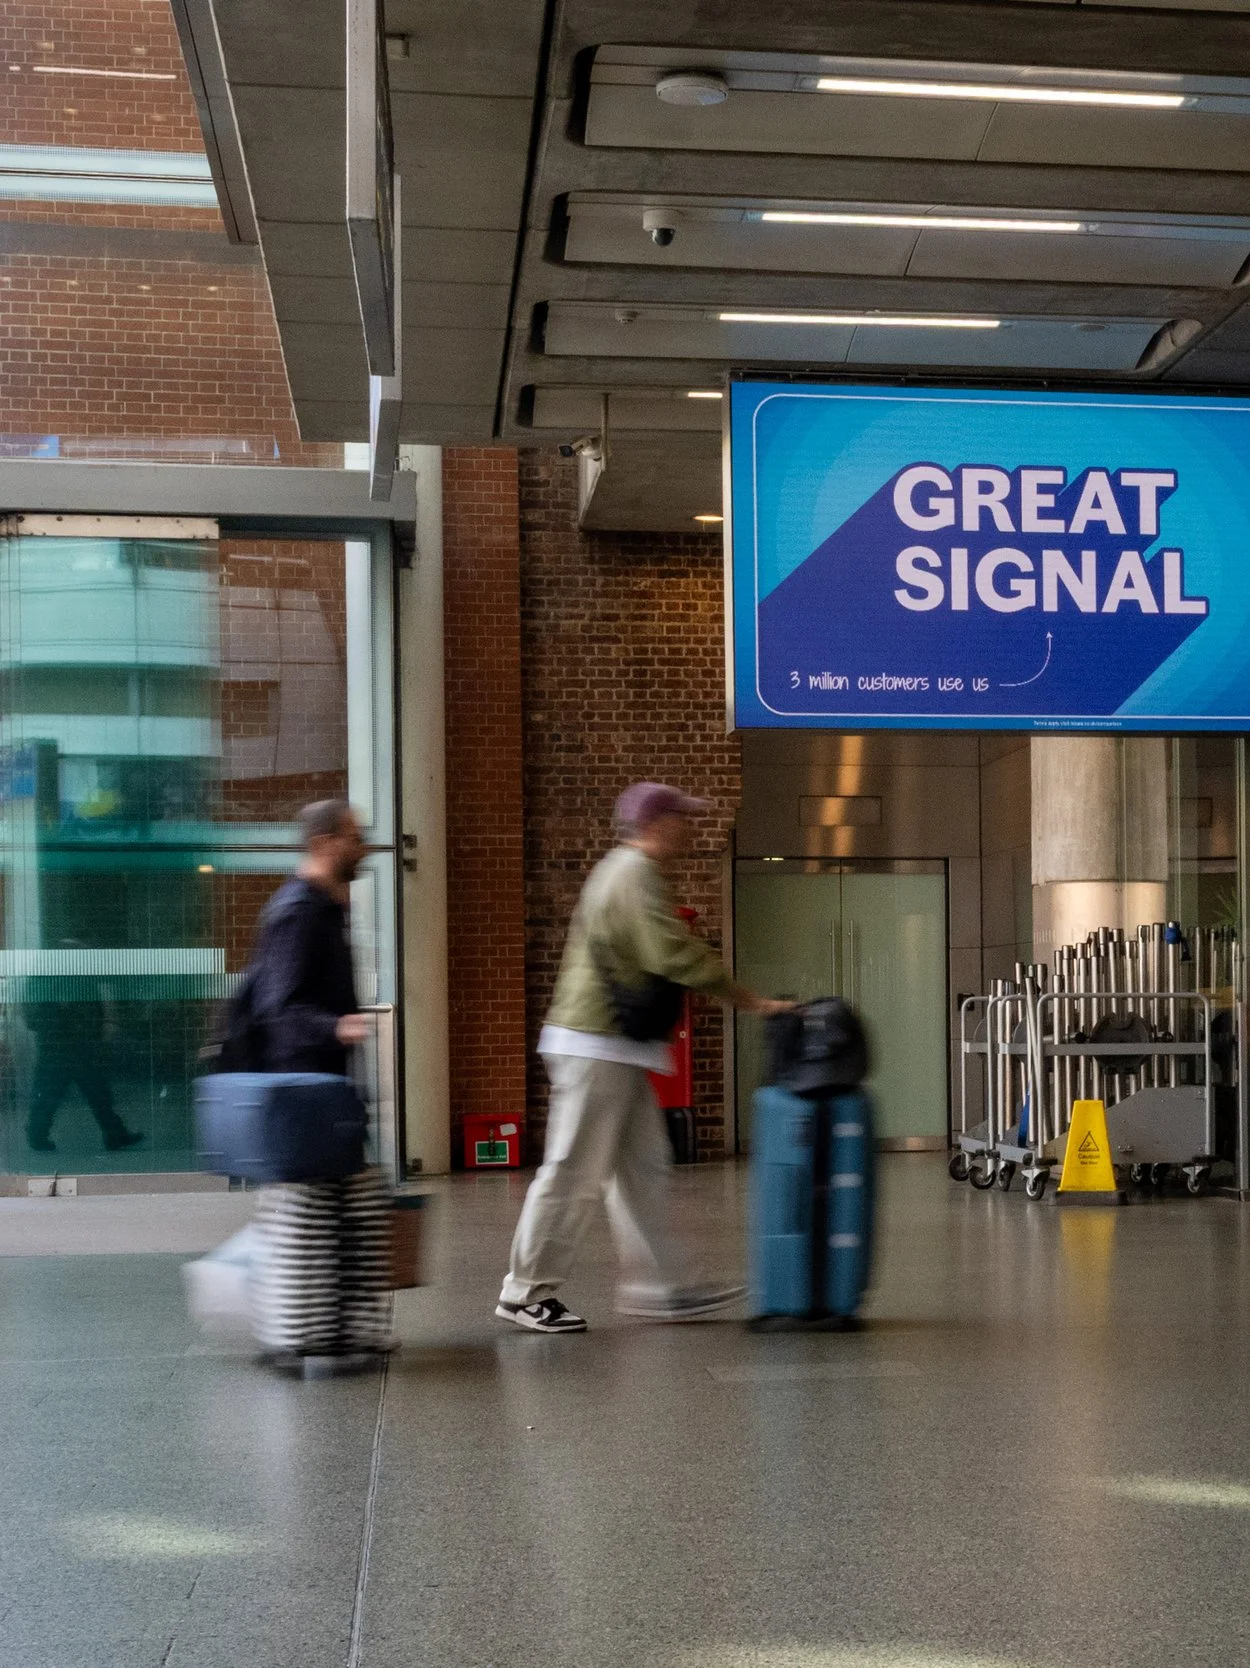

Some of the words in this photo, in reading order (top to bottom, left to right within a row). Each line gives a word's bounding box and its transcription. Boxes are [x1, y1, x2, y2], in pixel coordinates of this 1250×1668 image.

[893, 465, 1176, 536] GREAT
[893, 547, 1208, 614] SIGNAL
[790, 671, 801, 689] 3
[809, 671, 849, 690] million
[858, 672, 929, 691] customers
[938, 676, 964, 692] use
[972, 676, 989, 692] us
